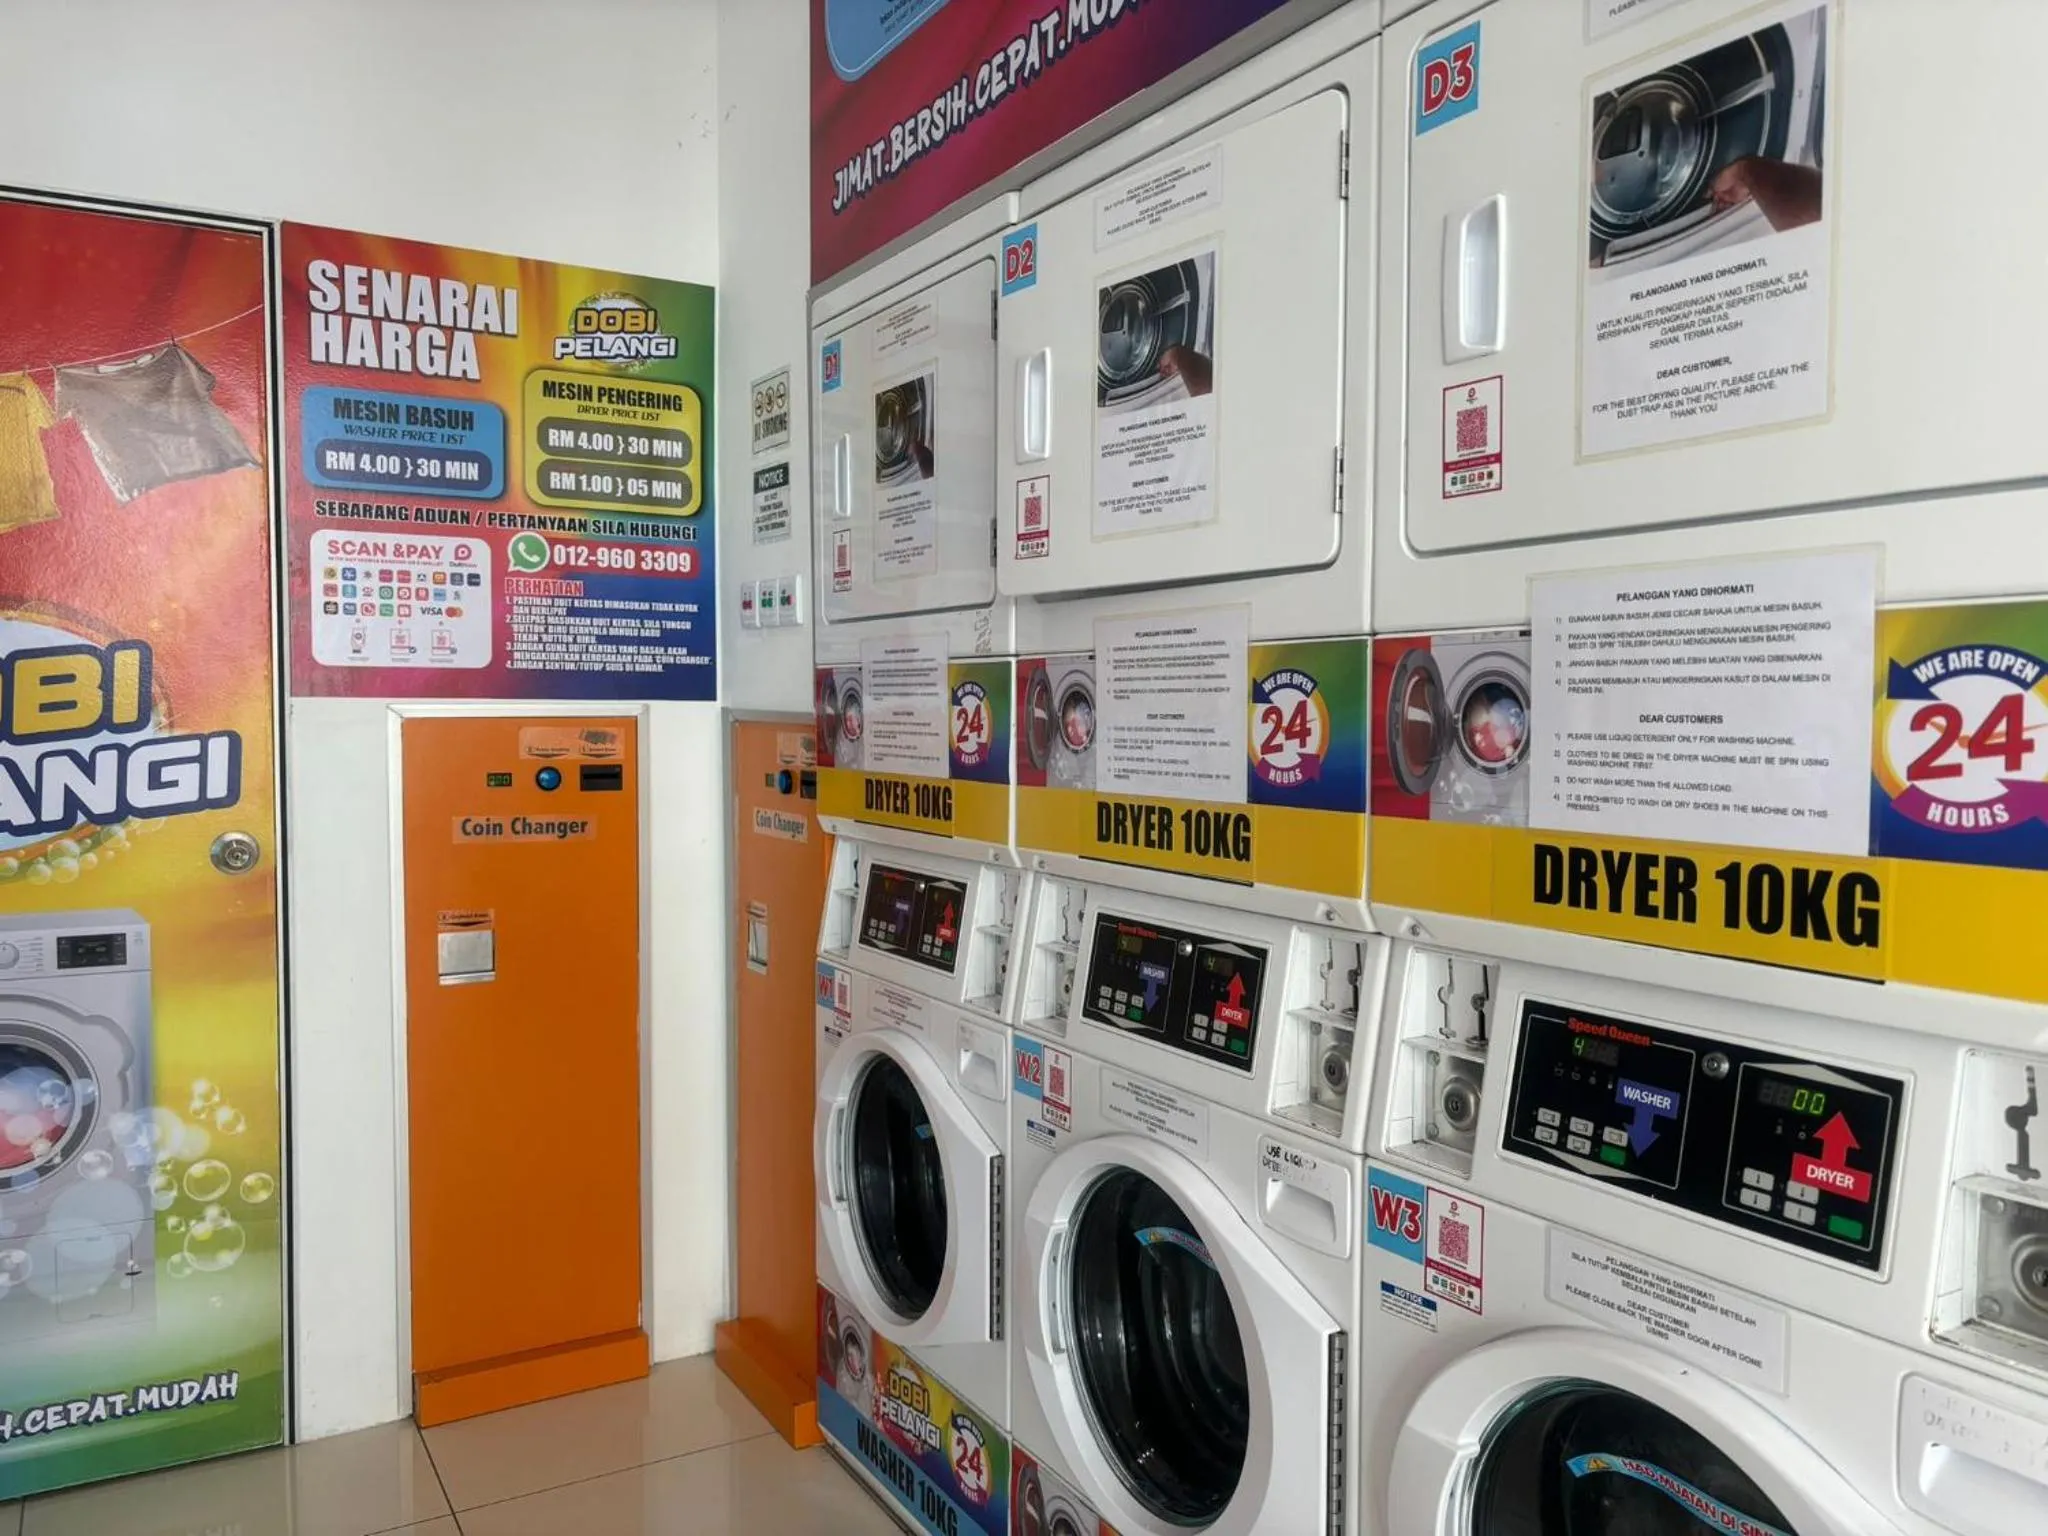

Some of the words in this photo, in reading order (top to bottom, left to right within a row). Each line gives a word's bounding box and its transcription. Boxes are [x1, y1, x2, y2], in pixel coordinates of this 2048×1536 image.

[1423, 42, 1475, 116] D3
[1005, 239, 1034, 282] D2
[1689, 272, 1714, 286] YANG
[1718, 286, 1742, 299] YANG
[308, 259, 518, 335] SENARAI
[574, 308, 657, 334] DOBI
[311, 311, 481, 381] HARGA
[555, 337, 677, 360] PELANGI
[824, 352, 838, 383] D1
[1656, 367, 1680, 380] DEAR
[543, 380, 593, 402] MESIN
[597, 386, 683, 412] PENGERING
[1592, 403, 1608, 414] FOR
[1610, 399, 1624, 410] THE
[1626, 395, 1647, 407] BEST
[1648, 388, 1680, 403] DRYING
[1721, 372, 1755, 388] PLEASE
[1757, 366, 1789, 380] CLEAN
[1790, 361, 1809, 373] THE
[1617, 407, 1638, 419] DUST
[1640, 403, 1661, 415] TRAP
[1663, 400, 1674, 410] AS
[1675, 399, 1684, 408] IN
[1686, 393, 1702, 405] THE
[1704, 386, 1741, 401] PICTURE
[333, 398, 400, 424] MESIN
[405, 405, 474, 431] BASUH
[577, 405, 610, 416] DRYER
[611, 408, 639, 420] PRICE
[641, 412, 661, 421] LIST
[1671, 407, 1697, 420] THANK
[1699, 403, 1718, 414] YOU
[344, 424, 397, 439] WASHER
[400, 430, 437, 443] PRICE
[441, 434, 467, 445] LIST
[548, 429, 573, 448] RM
[577, 432, 614, 451] 4.00
[628, 437, 649, 455] 30
[652, 440, 683, 458] MIN
[325, 450, 355, 471] RM
[360, 452, 400, 474] 4.00
[417, 459, 441, 477] 30
[446, 461, 479, 480] MIN
[550, 472, 575, 490] RM
[579, 475, 612, 493] 1.00
[627, 479, 648, 496] 05
[652, 481, 682, 499] MIN
[315, 500, 409, 521] SEBARANG
[413, 508, 470, 525] ADUAN
[487, 512, 588, 533] PERTANYAAN
[592, 520, 626, 535] SILA
[629, 523, 697, 541] HUBUNGI
[328, 539, 387, 558] SCAN
[393, 543, 444, 561] &PAY
[553, 544, 636, 569] 012-960
[640, 549, 692, 573] 3309
[505, 577, 584, 596] PERHATIAN
[1616, 590, 1670, 602] PELANGGAN
[1672, 587, 1698, 598] YANG
[1700, 584, 1754, 597] DIHORMATI
[420, 606, 444, 616] VISA
[1912, 661, 1946, 684] WE
[1949, 649, 1984, 670] ARE
[1988, 650, 2041, 683] OPEN
[1262, 677, 1274, 693] WE
[1276, 672, 1291, 685] ARE
[1292, 673, 1315, 694] OPEN
[957, 703, 983, 743] 24
[1260, 699, 1312, 756] 24
[1639, 714, 1664, 723] DEAR
[1666, 714, 1724, 724] CUSTOMERS
[1906, 693, 2036, 782] 24
[1268, 768, 1303, 785] HOURS
[864, 778, 910, 815] DRYER
[914, 783, 953, 822] 10KG
[1926, 802, 2010, 828] HOURS
[461, 818, 503, 836] Coin
[511, 817, 588, 839] Changer
[755, 809, 773, 830] Coin
[774, 811, 805, 839] Changer
[1097, 801, 1174, 851] DRYER
[1180, 809, 1251, 862] 10KG
[1533, 843, 1698, 923] DRYER
[1714, 861, 1881, 948] 10KG
[1016, 1050, 1041, 1085] W2
[1623, 1085, 1672, 1110] WASHER
[1806, 1163, 1855, 1190] DRYER
[1371, 1185, 1422, 1243] W3
[1651, 1273, 1671, 1286] YANG
[1627, 1300, 1647, 1312] DEAR
[1566, 1284, 1591, 1299] PLEASE
[1592, 1295, 1615, 1310] CLOSE
[1617, 1305, 1636, 1318] BACK
[1638, 1313, 1652, 1325] THE
[1654, 1320, 1686, 1338] WASHER
[1687, 1333, 1710, 1347] DOOR
[1712, 1343, 1738, 1359] AFTER
[1739, 1352, 1762, 1369] DONE
[1646, 1325, 1669, 1341] USING
[889, 1373, 930, 1416] DOBI
[881, 1396, 941, 1450] PELANGI
[856, 1419, 915, 1502] WASHER
[955, 1436, 983, 1481] 24
